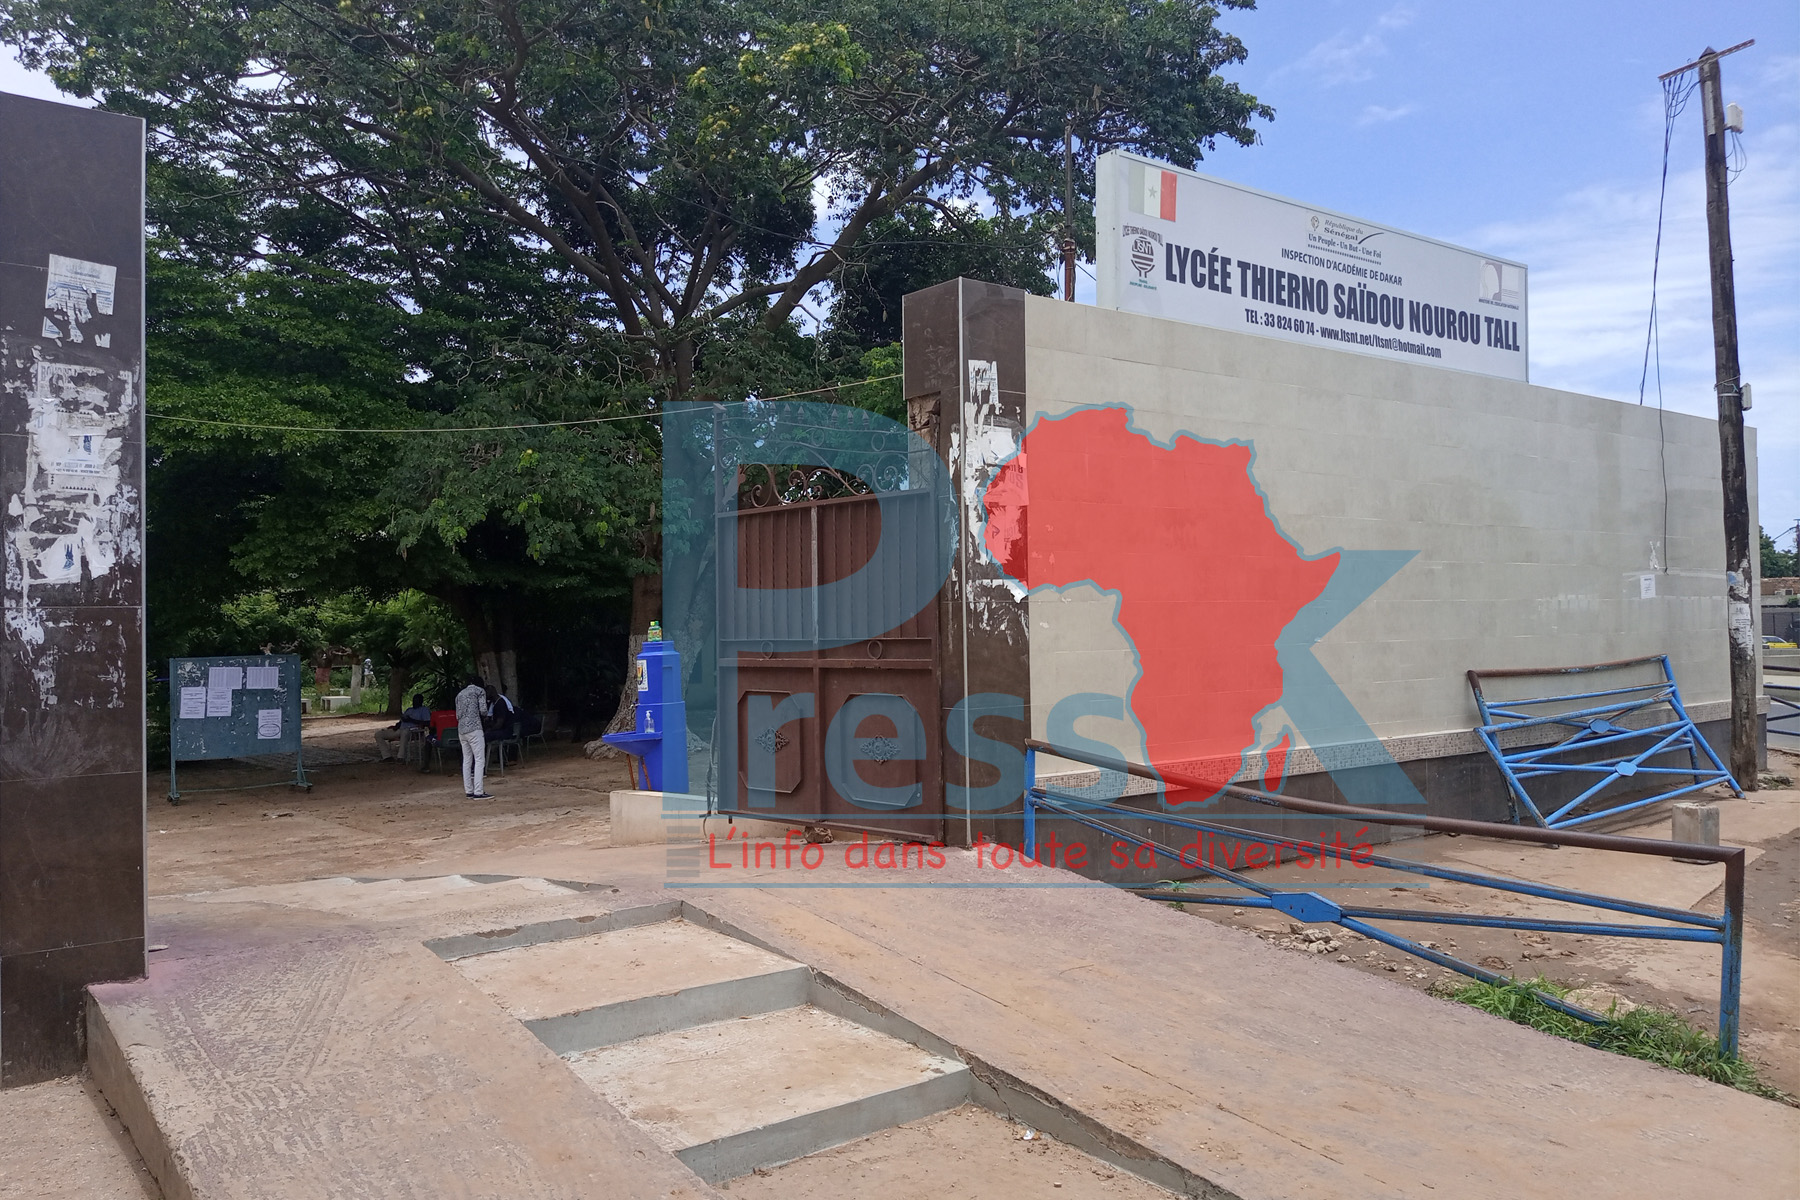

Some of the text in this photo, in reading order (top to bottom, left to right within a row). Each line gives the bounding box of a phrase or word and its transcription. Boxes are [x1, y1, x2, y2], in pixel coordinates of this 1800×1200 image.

[1323, 227, 1359, 241] Sénégal
[1324, 219, 1364, 235] République du
[1308, 233, 1318, 242] Un
[1318, 236, 1336, 247] Peuple
[1340, 241, 1348, 250] Un
[1349, 243, 1358, 252] But
[1362, 247, 1372, 256] Une
[1373, 250, 1382, 259] Foi
[1281, 248, 1403, 286] INSPECTION D'ACADÉMIE DE DAKAR
[1165, 242, 1520, 352] LYCÉE THIERNO SAÏDOU NOUROU TALL
[1264, 312, 1275, 328] 33
[1277, 315, 1292, 331] 824
[1294, 319, 1305, 334] 60
[1306, 321, 1315, 336] 74
